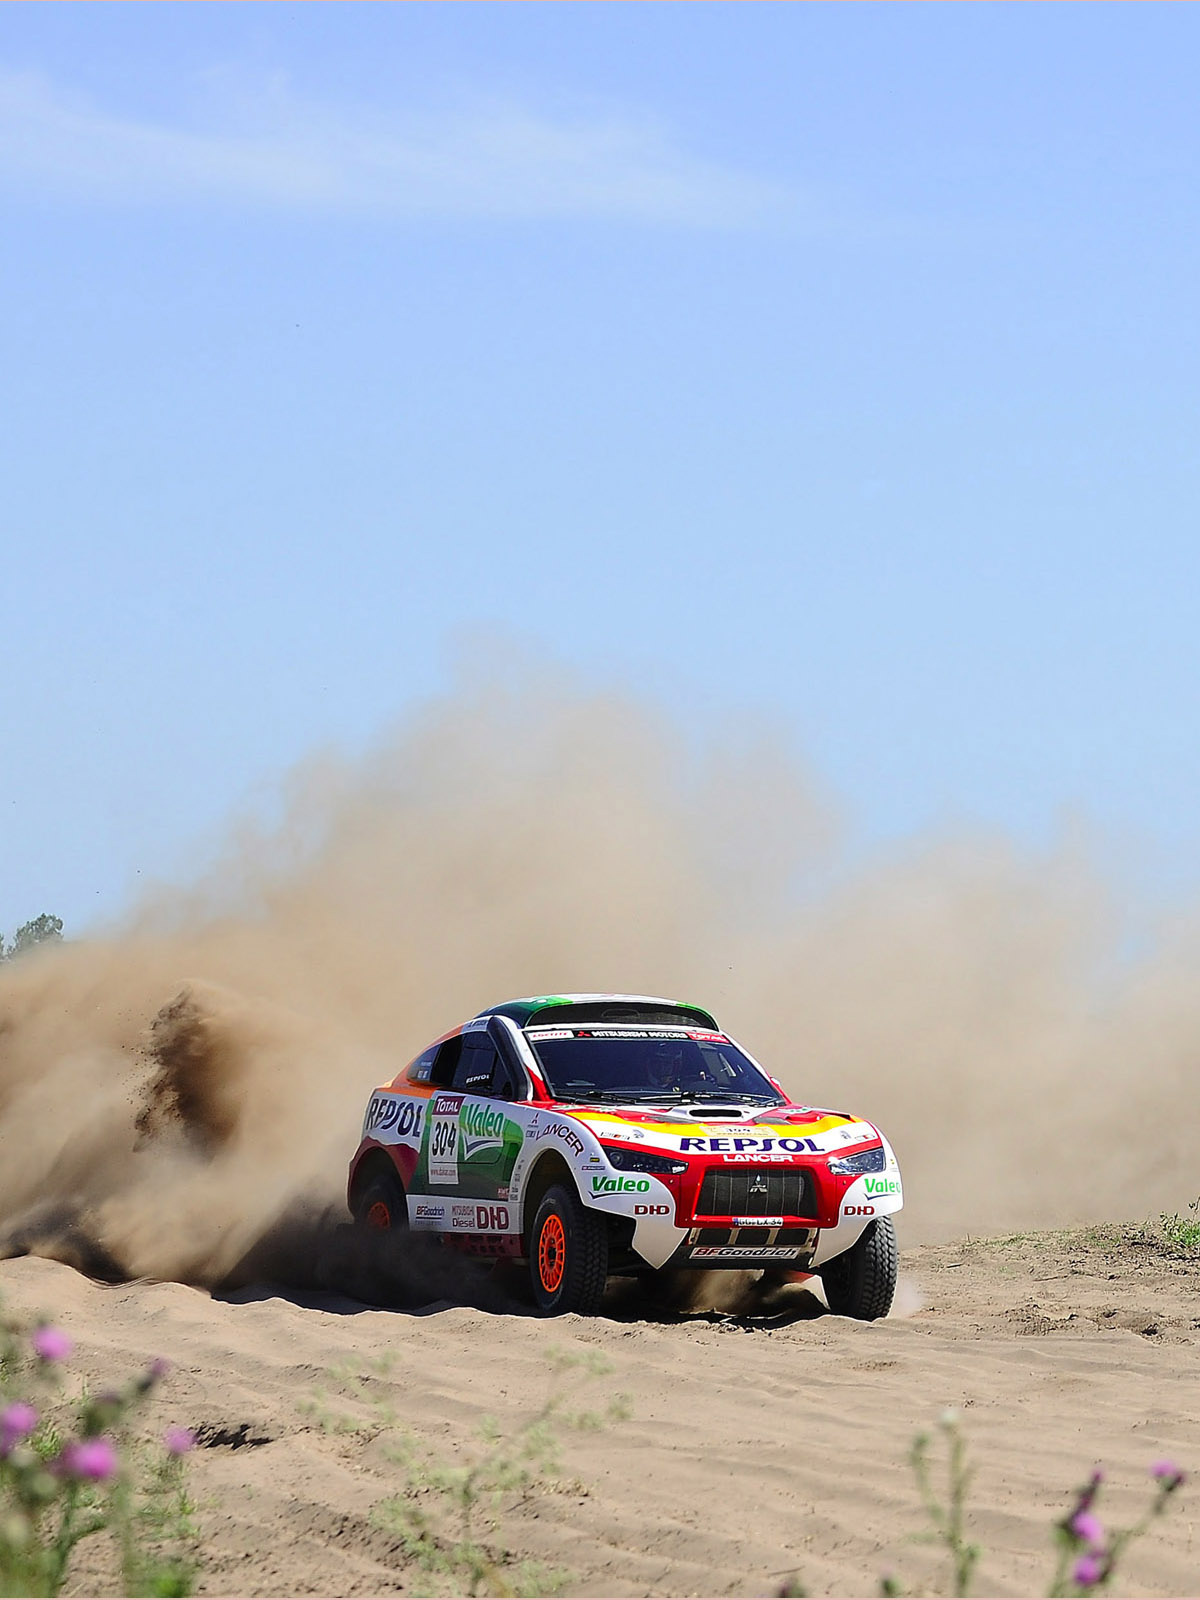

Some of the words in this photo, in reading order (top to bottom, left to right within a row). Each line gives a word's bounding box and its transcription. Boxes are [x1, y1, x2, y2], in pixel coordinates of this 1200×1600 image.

[592, 1031, 647, 1039] MITSUBISHI
[648, 1031, 687, 1039] MOTORS
[436, 1098, 458, 1112] TOTAL
[366, 1098, 423, 1137] REPSOL
[467, 1103, 504, 1137] Valeo
[432, 1121, 457, 1156] 304
[536, 1124, 584, 1157] LANCER
[680, 1138, 825, 1152] REPSOL
[723, 1154, 794, 1163] LANCER
[592, 1176, 650, 1192] Valeo
[864, 1178, 901, 1193] Valeo
[453, 1217, 475, 1228] Diesel
[694, 1247, 797, 1257] BFGoodrich
